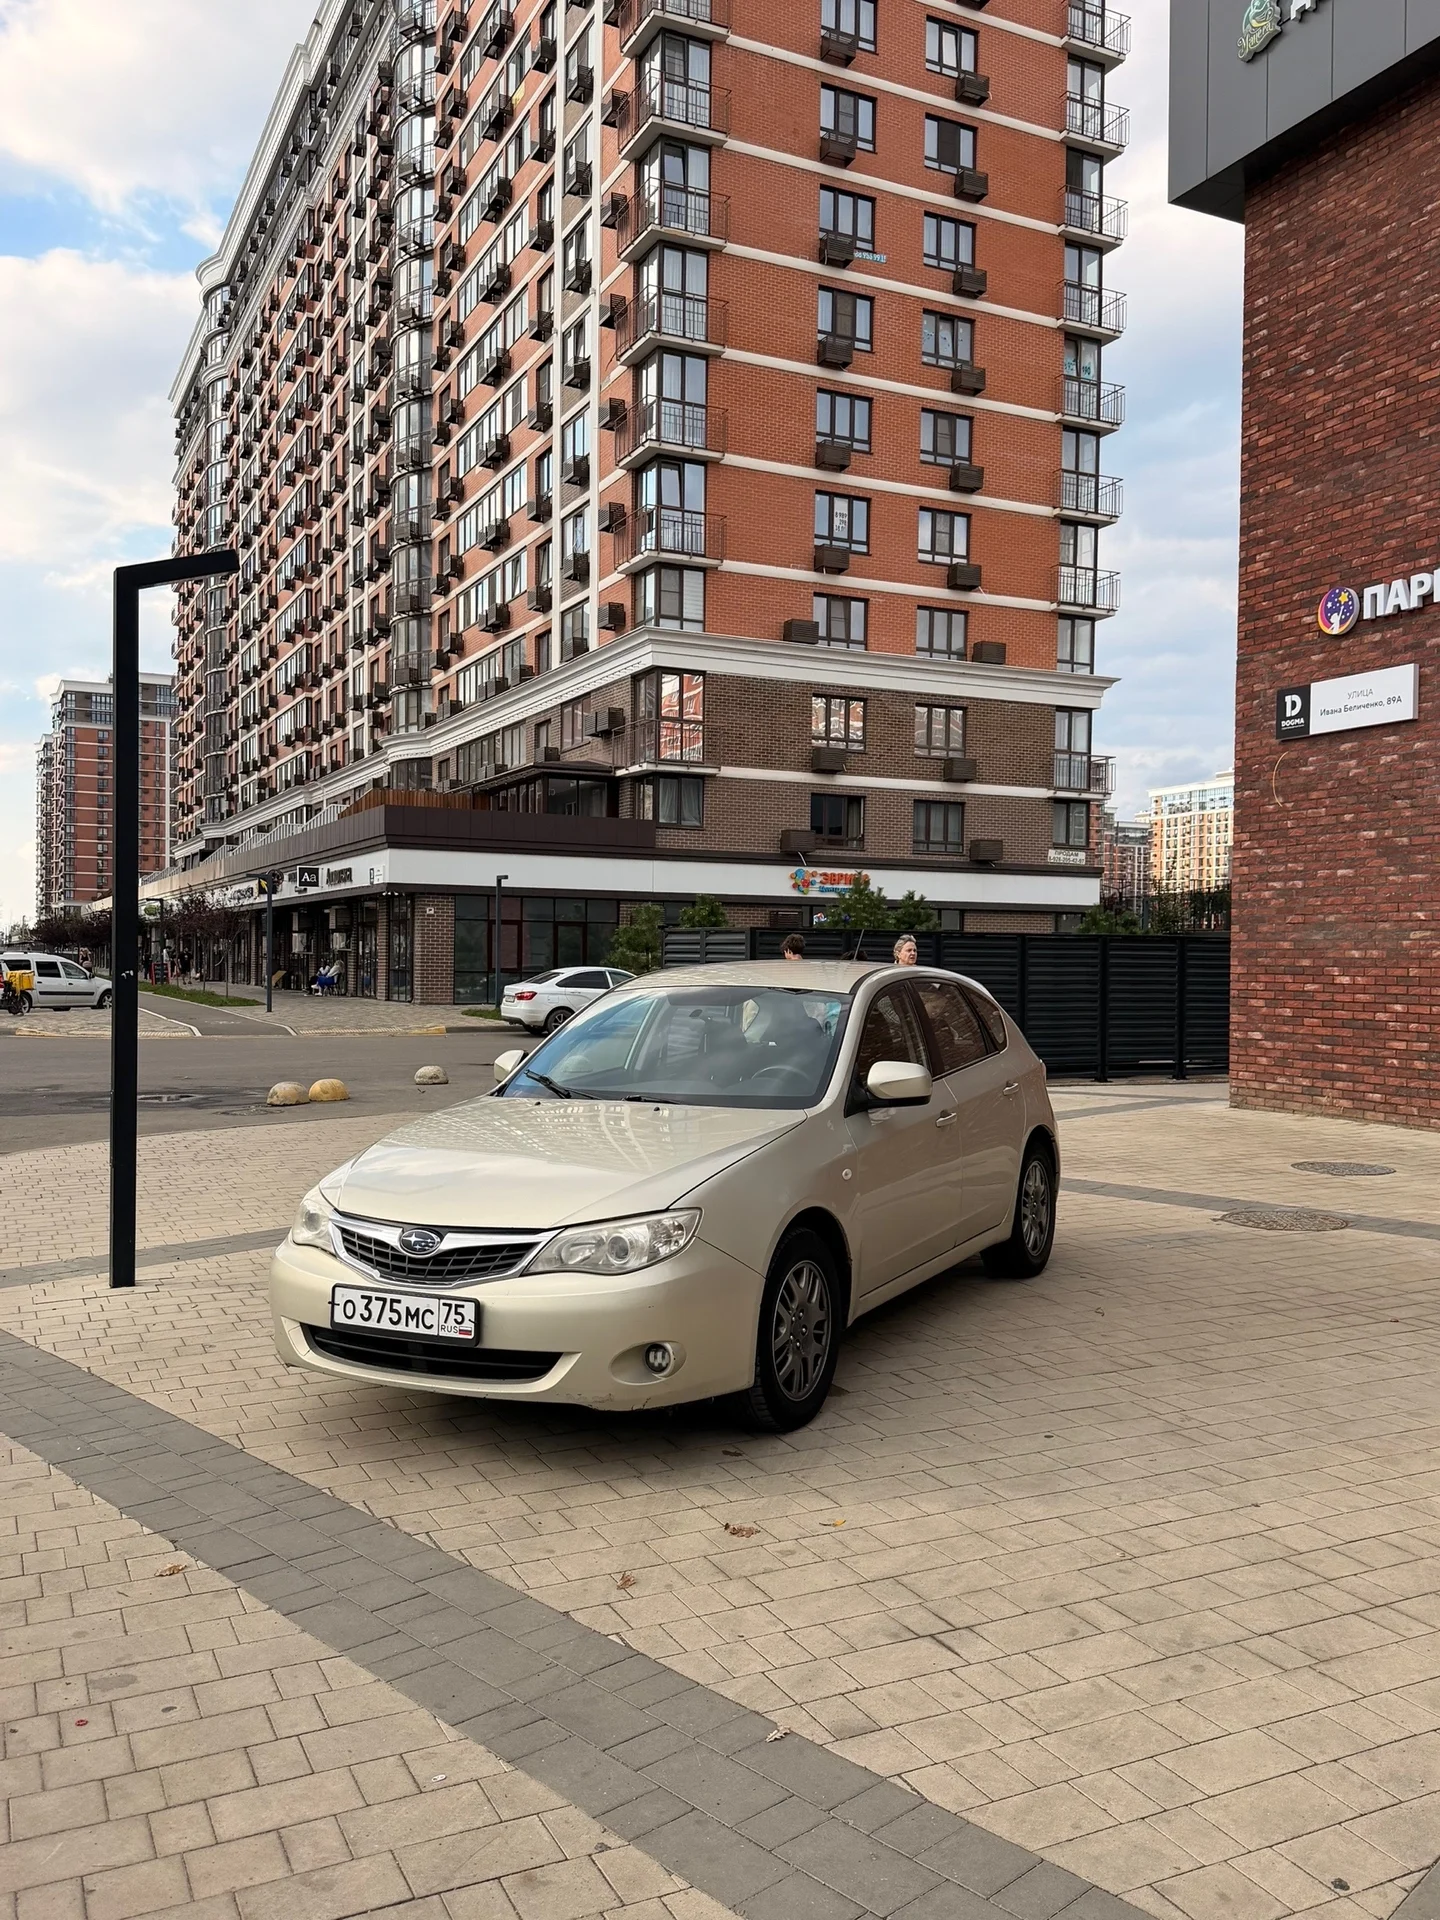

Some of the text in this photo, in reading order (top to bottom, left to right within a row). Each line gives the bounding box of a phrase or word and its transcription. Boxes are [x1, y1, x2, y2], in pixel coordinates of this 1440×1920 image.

[1347, 688, 1374, 700] УЛИЦА
[1320, 707, 1342, 717] Ивана
[1344, 699, 1385, 713] Беличенко,
[1281, 717, 1305, 727] DOGMA
[442, 1302, 465, 1325] 75
[440, 1325, 459, 1334] RUS
